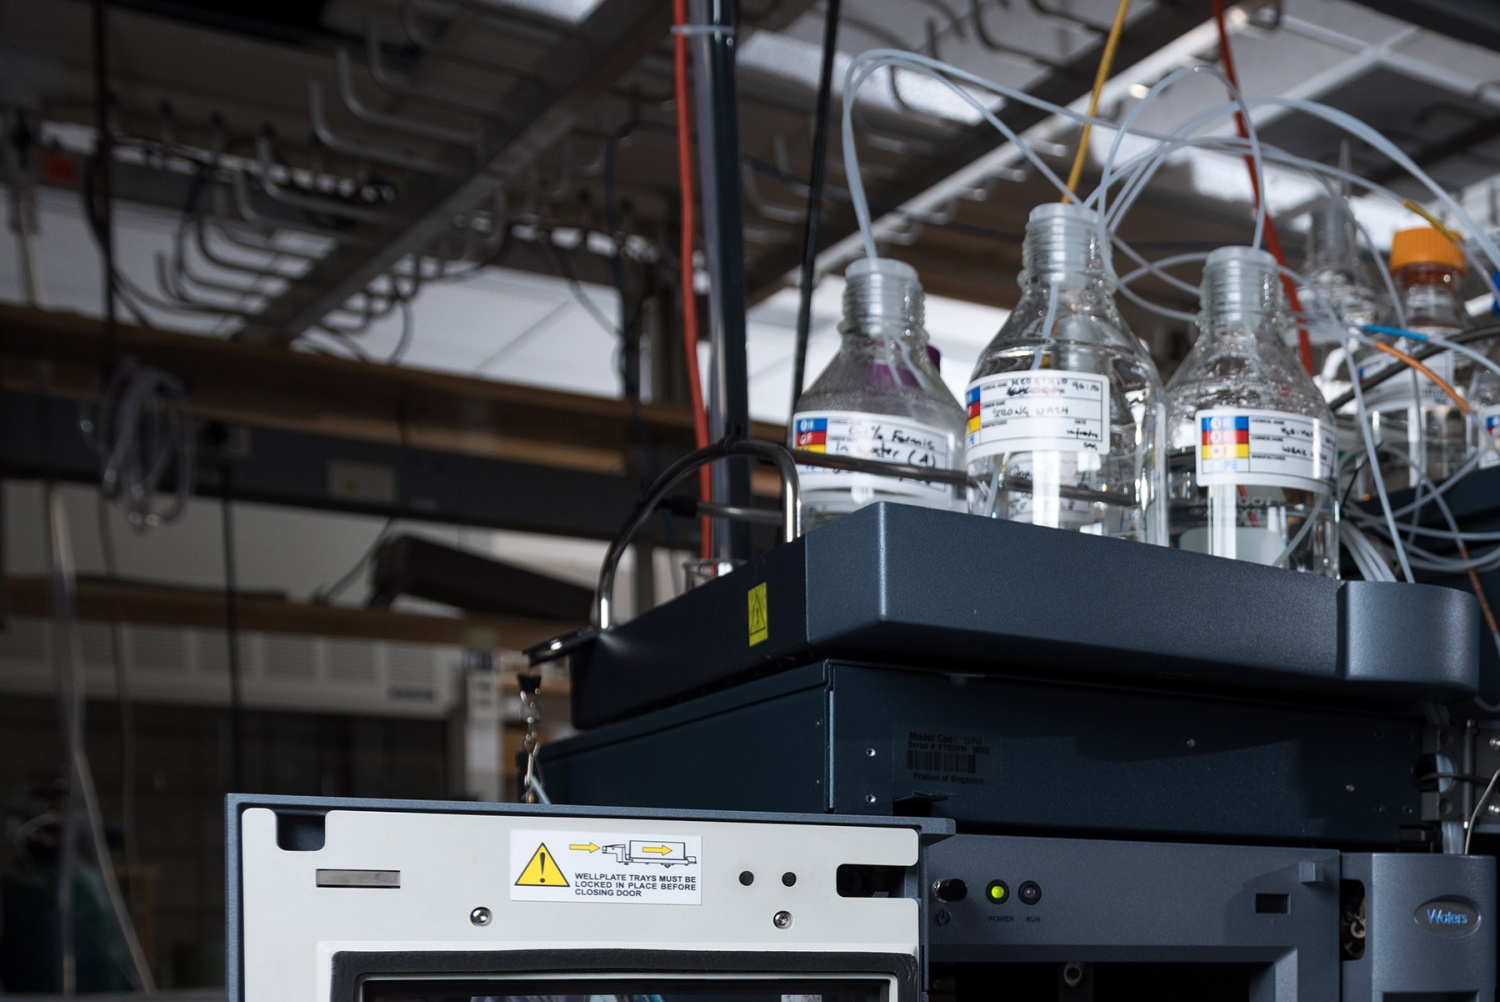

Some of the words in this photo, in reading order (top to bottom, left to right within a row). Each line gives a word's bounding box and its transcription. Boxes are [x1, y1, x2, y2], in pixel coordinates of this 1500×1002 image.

[574, 872, 628, 882] WELLPLATE
[629, 874, 657, 883] TRAYS
[659, 875, 683, 883] MUST
[685, 876, 697, 884] BE
[574, 880, 613, 889] LOCKED
[615, 881, 625, 890] IN
[628, 882, 657, 890] PLACE
[660, 883, 697, 891] BEFORE
[574, 888, 614, 897] CLOSING
[616, 889, 642, 898] DOOR
[987, 914, 1014, 923] POWER
[1025, 915, 1041, 923] RUN
[1426, 907, 1469, 925] Waters
